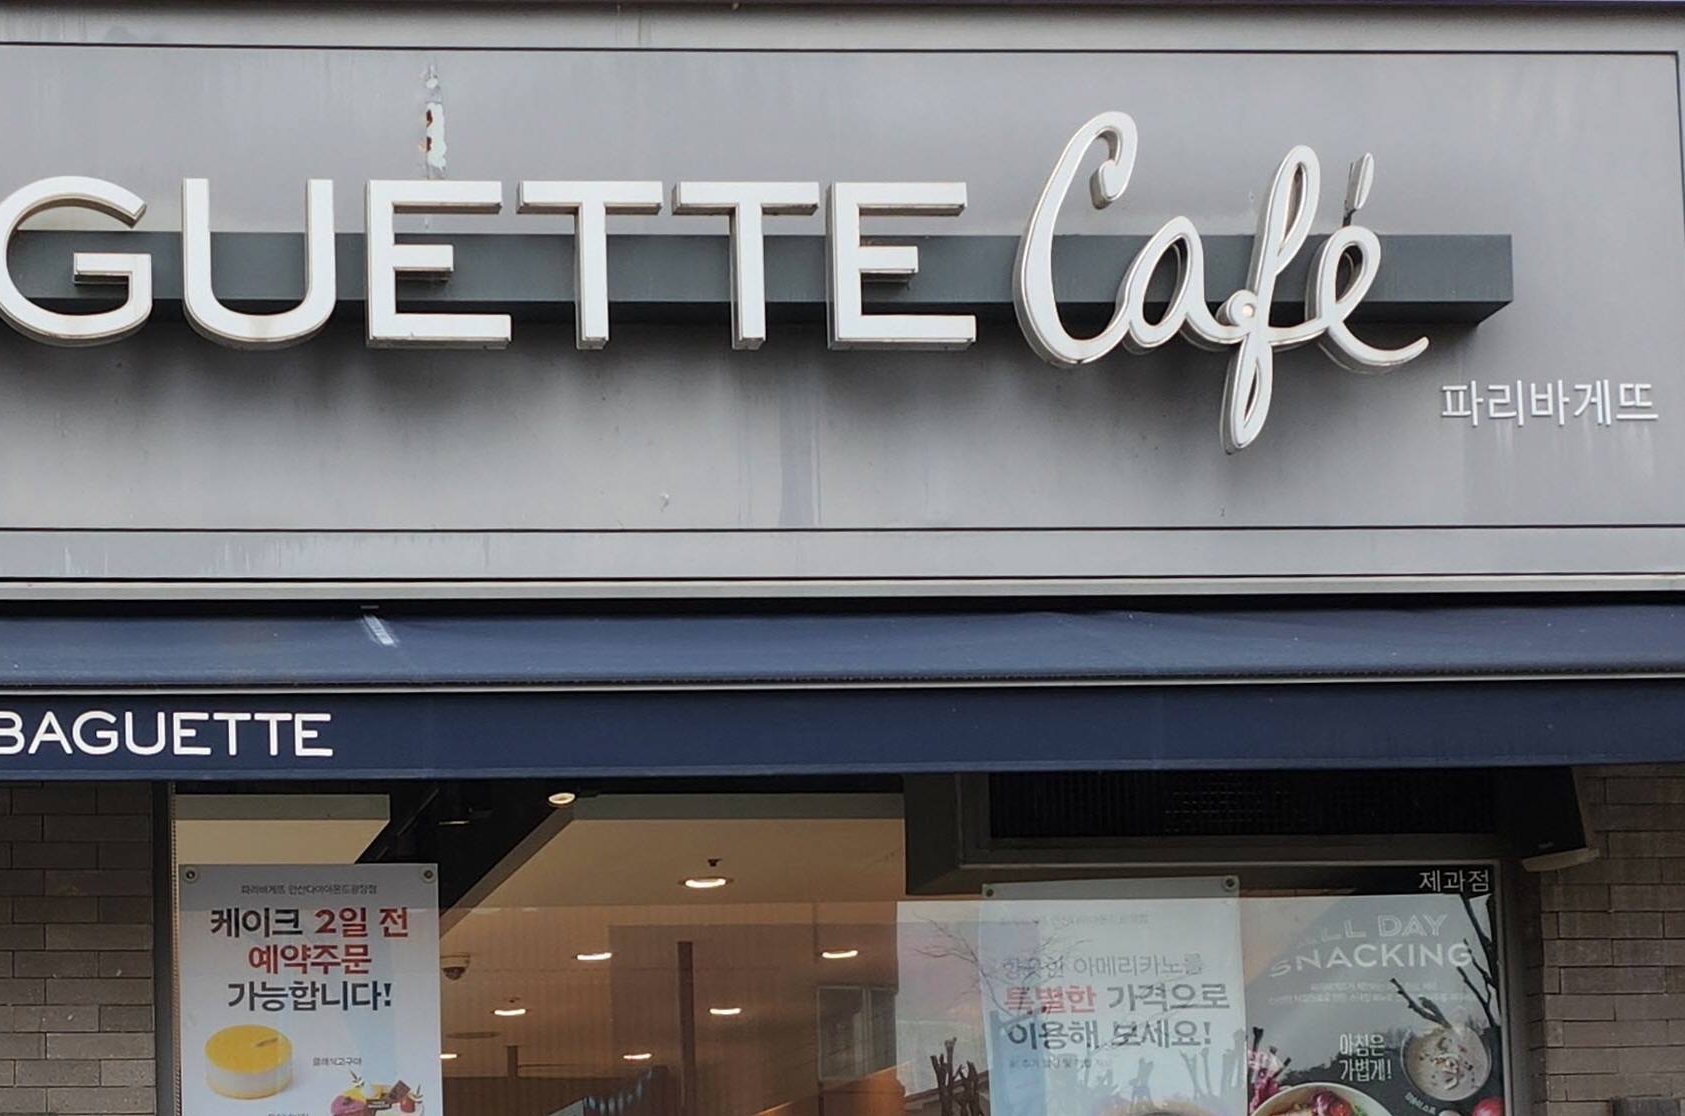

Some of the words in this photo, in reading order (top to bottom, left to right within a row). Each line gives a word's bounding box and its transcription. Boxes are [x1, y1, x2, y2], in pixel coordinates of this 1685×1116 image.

[1012, 111, 1431, 454] Café
[1441, 379, 1658, 427] 파리바게뜨
[240, 884, 288, 895] 파리바게뜨
[1418, 869, 1490, 893] 제과점
[210, 907, 304, 939] 케이크
[314, 907, 369, 938] 2일
[378, 906, 409, 938] 전
[1377, 914, 1448, 937] DAY
[248, 944, 373, 975] 예약주문
[1073, 953, 1203, 979] 아메리카노를
[1268, 942, 1473, 979] SNACKING
[227, 980, 393, 1012] 가능합니다!
[1003, 984, 1098, 1014] 특별한
[1107, 983, 1231, 1012] 가격으로
[1007, 1020, 1099, 1050] 이용해
[1111, 1019, 1212, 1049] 보세요!
[1339, 1033, 1385, 1057] 아침은
[1339, 1057, 1392, 1082] 가볍게!
